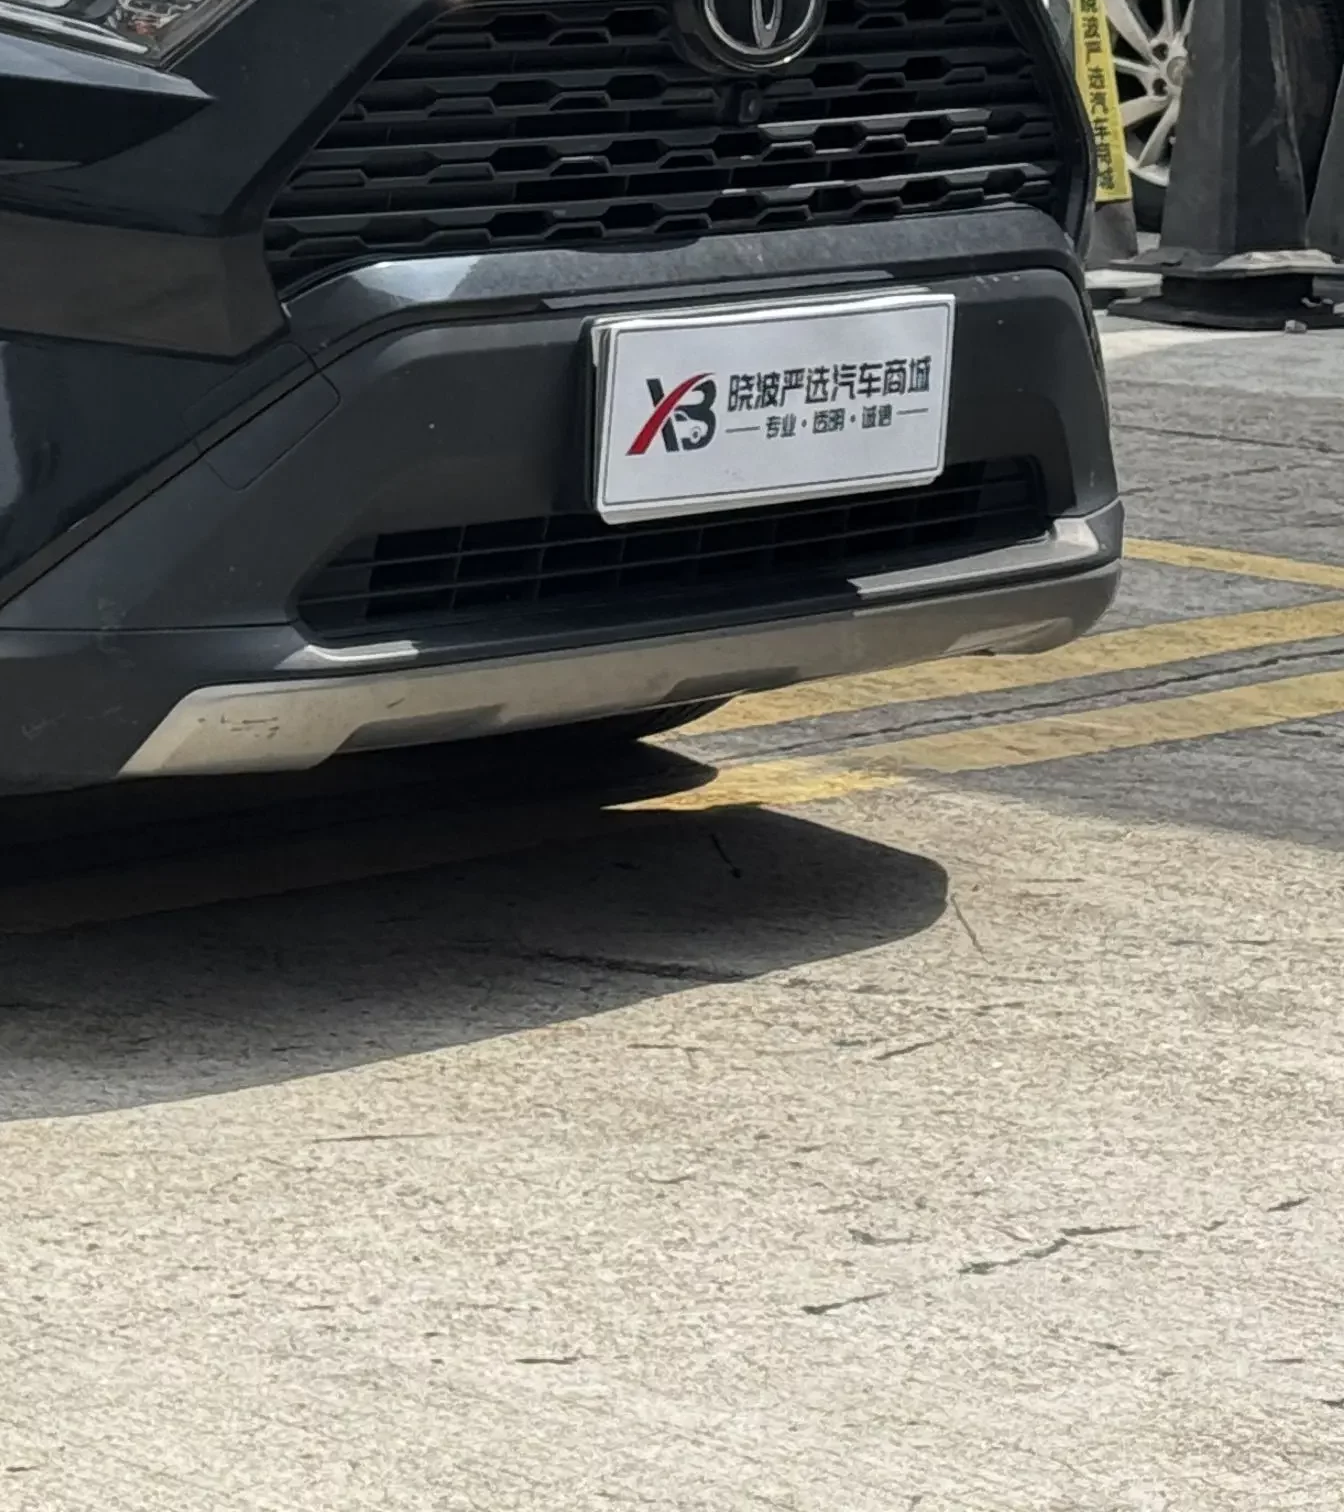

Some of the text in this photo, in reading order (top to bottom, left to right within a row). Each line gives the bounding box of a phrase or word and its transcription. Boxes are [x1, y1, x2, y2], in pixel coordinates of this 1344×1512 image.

[727, 355, 932, 413] 晓波严选汽车商城
